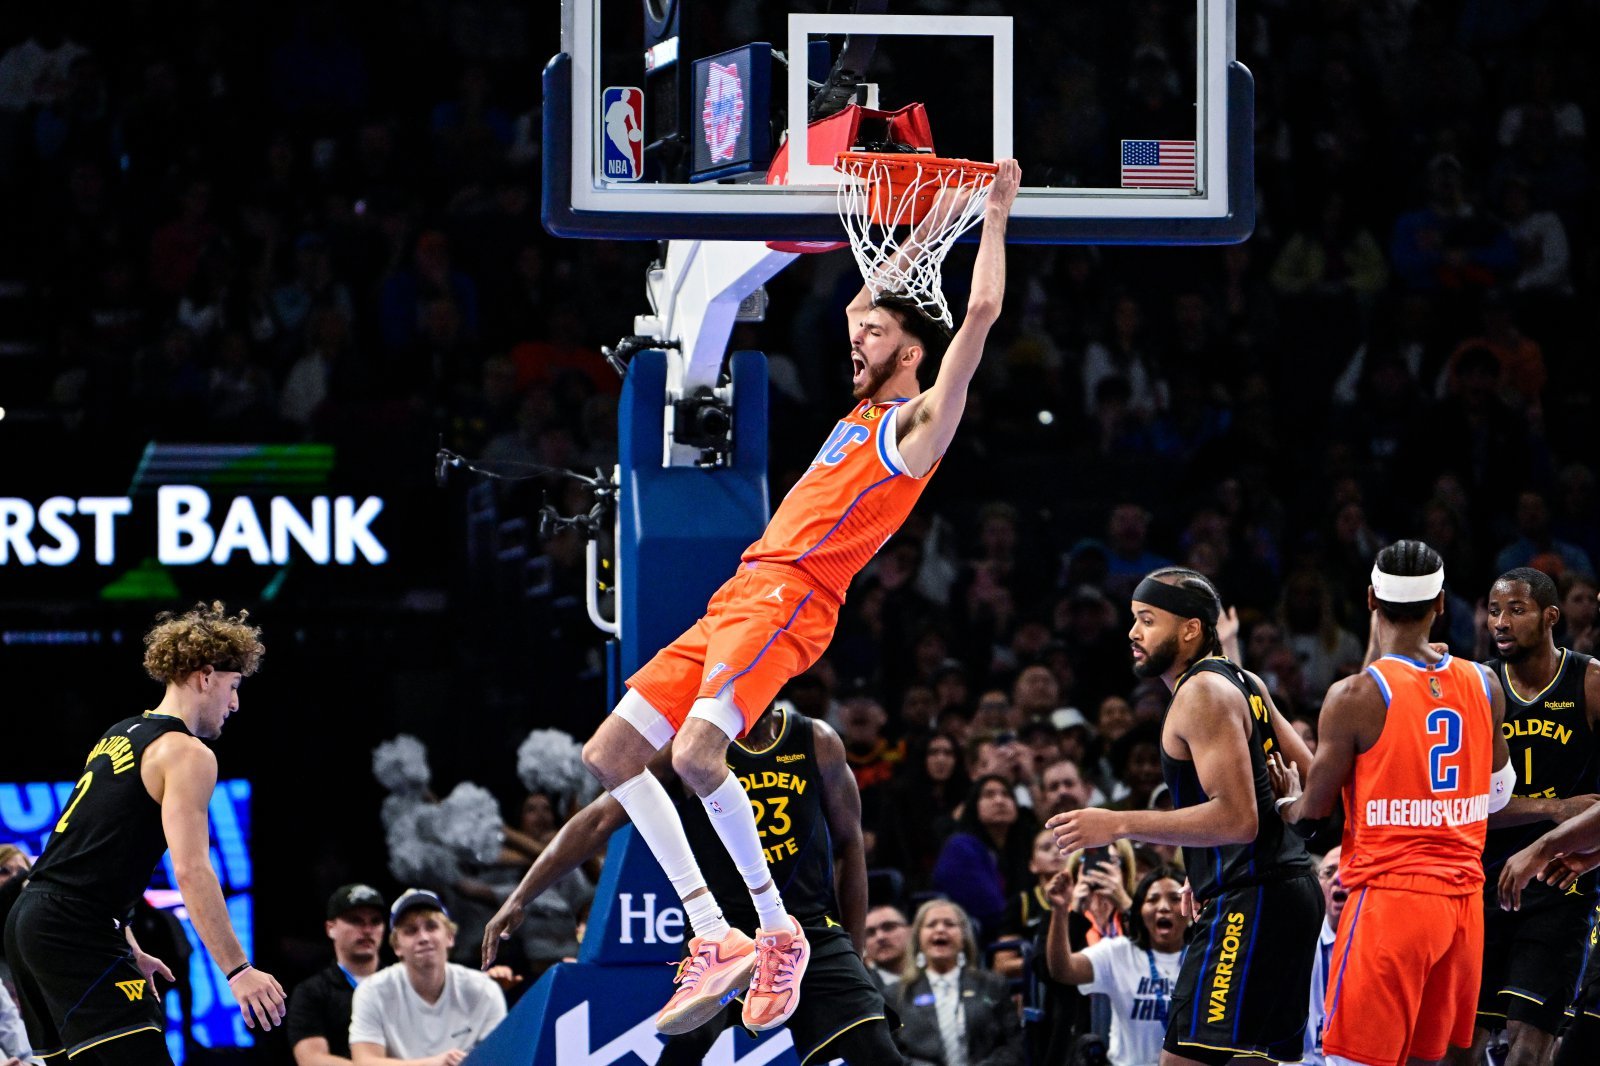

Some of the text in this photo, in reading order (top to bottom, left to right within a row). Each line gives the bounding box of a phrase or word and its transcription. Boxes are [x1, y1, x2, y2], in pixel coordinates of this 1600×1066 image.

[608, 159, 628, 175] NBA
[1544, 701, 1575, 711] Rakuten
[776, 753, 805, 763] Rakuten
[1426, 707, 1463, 793] 2
[1524, 747, 1532, 785] 1
[55, 770, 93, 833] 2
[751, 796, 792, 837] 23
[619, 893, 685, 944] He
[1207, 912, 1245, 1024] WARRIORS
